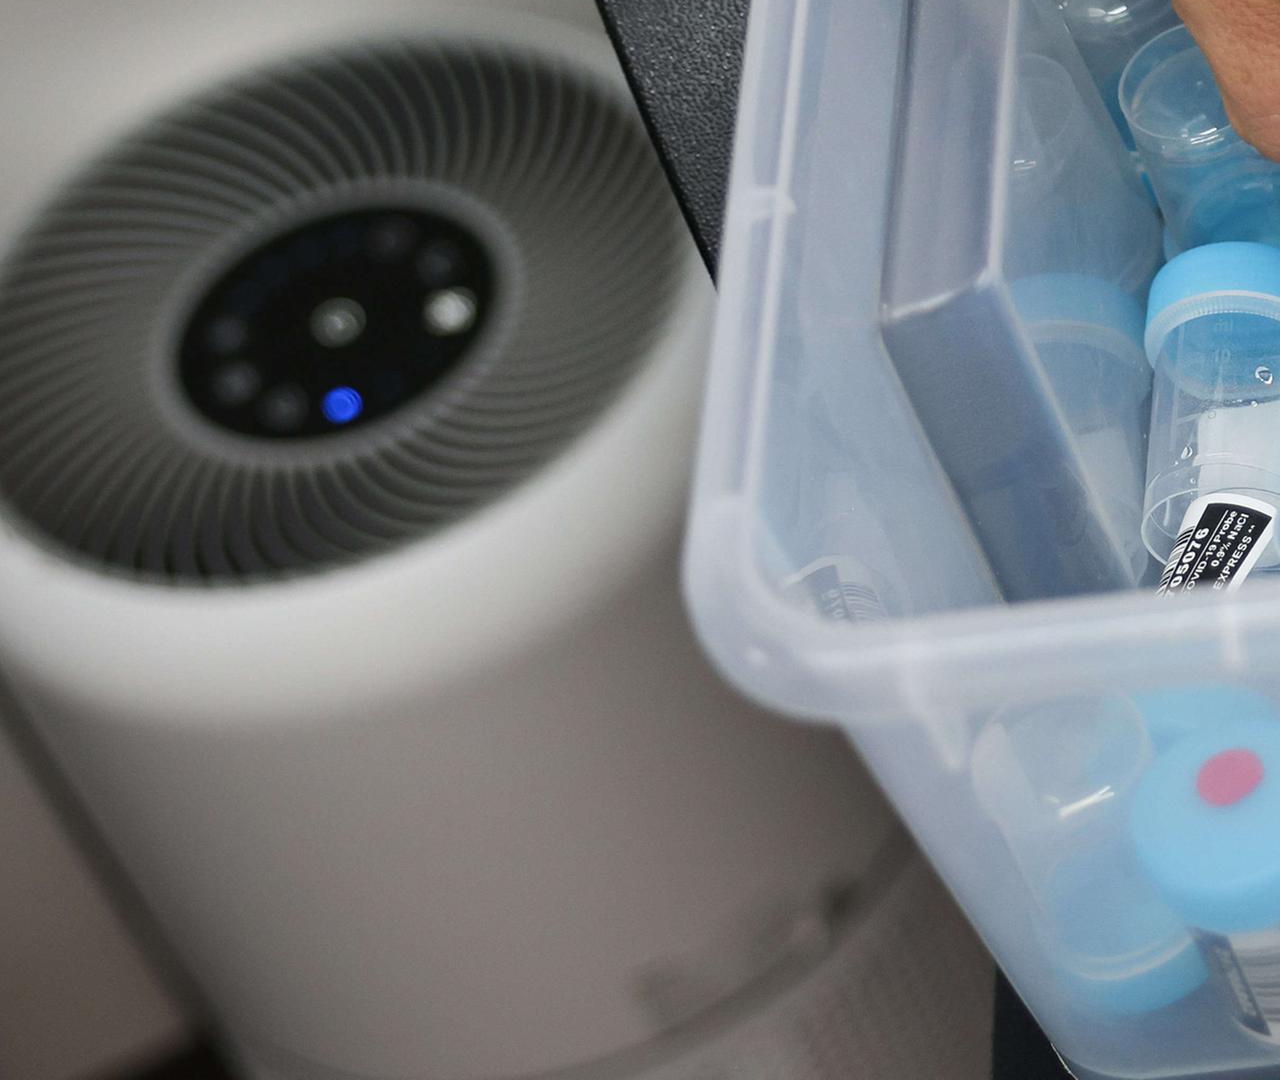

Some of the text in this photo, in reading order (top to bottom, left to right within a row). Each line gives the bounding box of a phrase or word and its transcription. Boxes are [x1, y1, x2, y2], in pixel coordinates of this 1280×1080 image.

[1185, 511, 1238, 591] OVID-19 Probe
[1226, 513, 1249, 540] NaCl
[1213, 535, 1252, 590] EXPRESS
